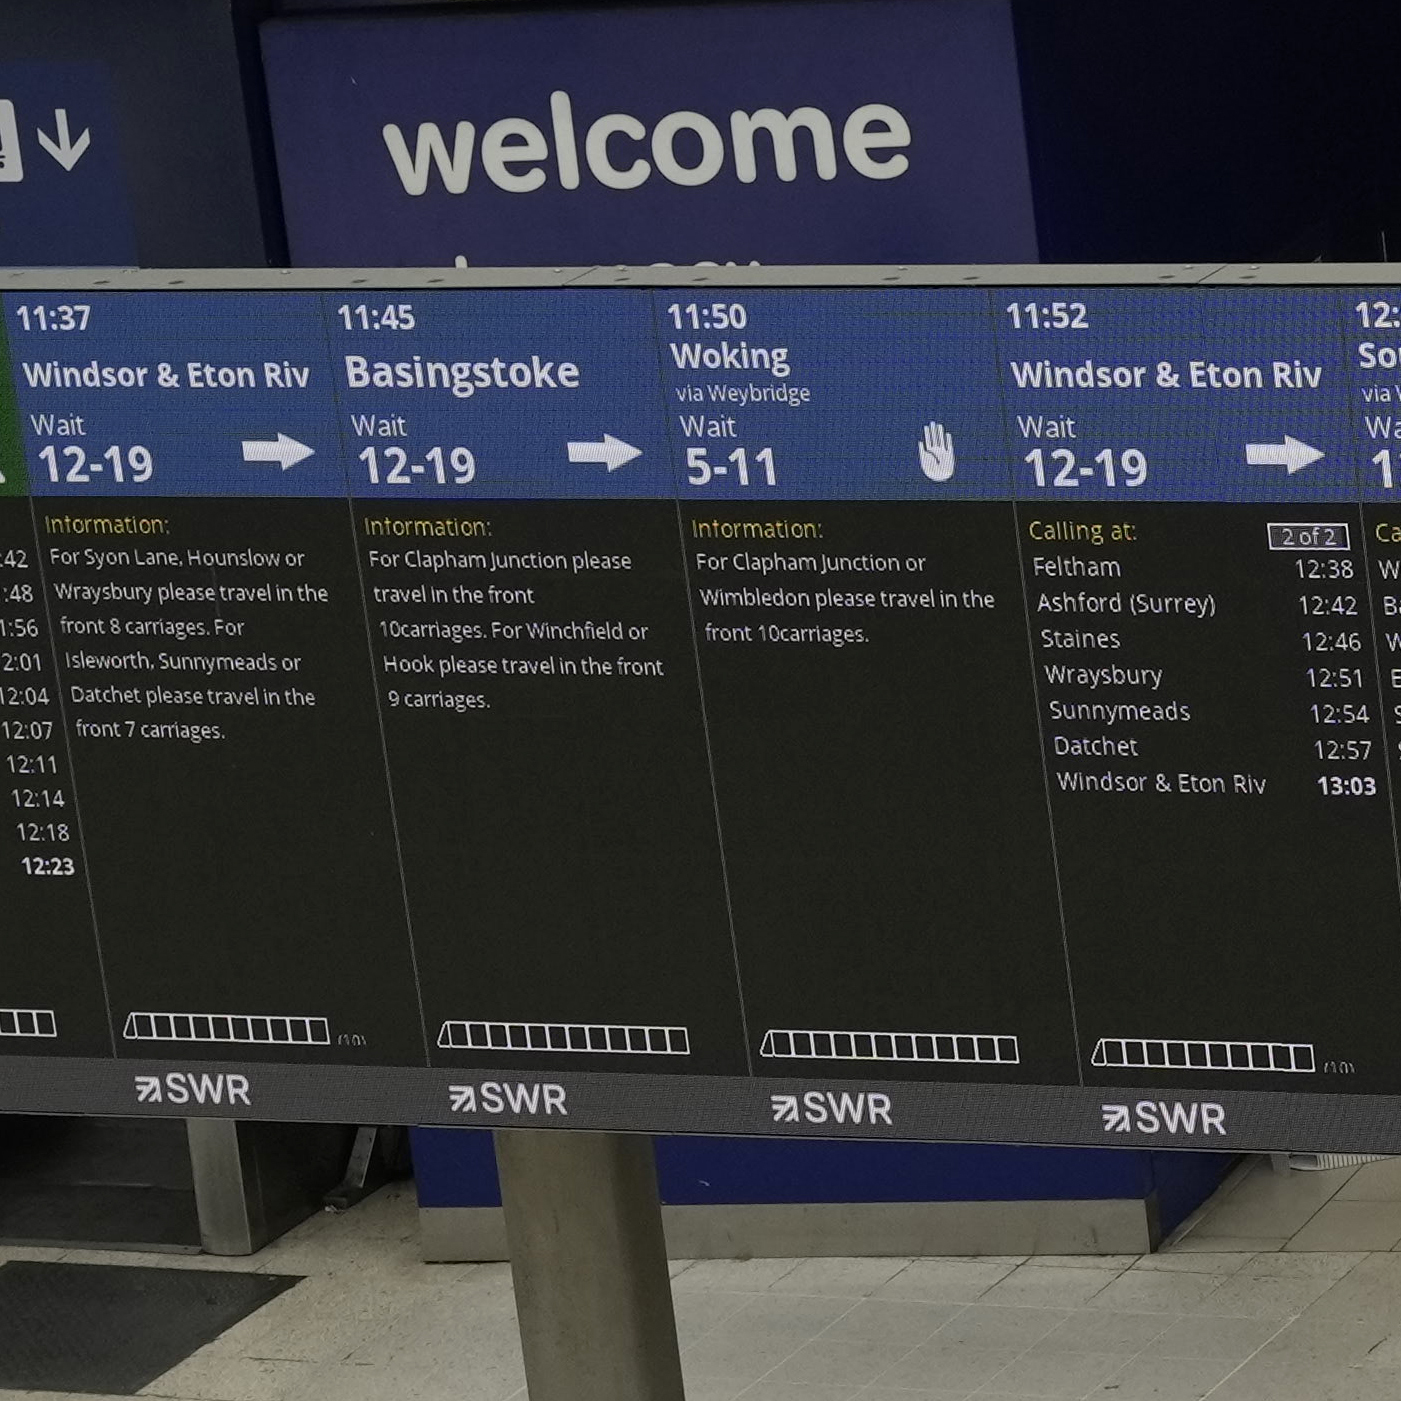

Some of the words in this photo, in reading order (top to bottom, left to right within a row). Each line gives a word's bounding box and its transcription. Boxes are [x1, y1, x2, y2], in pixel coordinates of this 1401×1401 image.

[382, 90, 912, 196] welcome
[16, 305, 91, 331] 11:37
[337, 304, 416, 330] 11:45
[667, 303, 747, 330] 11:50
[1006, 302, 1089, 329] 11:52
[669, 341, 791, 378] Woking
[22, 360, 148, 388] Windsor
[157, 362, 180, 388] &
[187, 362, 256, 388] Eton
[263, 360, 309, 388] Riv
[345, 355, 579, 398] Basingstoke
[1010, 360, 1146, 388] Windsor
[1156, 361, 1180, 388] &
[1189, 361, 1263, 388] Eton
[1272, 360, 1322, 388] Riv
[675, 381, 704, 402] via
[707, 382, 811, 407] Weybridge
[1359, 382, 1392, 403] via
[30, 412, 87, 436] Wait
[350, 414, 408, 437] Wait
[679, 414, 737, 438] Wait
[1016, 414, 1077, 438] Wait
[38, 445, 153, 483] 12-19
[359, 446, 475, 484] 12-19
[686, 447, 776, 486] 5-11
[1024, 448, 1147, 487] 12-19
[1029, 520, 1104, 546] Calling
[1033, 555, 1121, 577] Feltham
[1295, 558, 1354, 579] 12:38
[53, 581, 153, 605] Wraysbury
[157, 581, 216, 606] please
[218, 583, 272, 602] travel
[276, 587, 294, 602] in
[296, 583, 329, 602] the
[699, 587, 811, 607] Wimbledon
[814, 587, 876, 612] please
[879, 588, 936, 608] travel
[939, 589, 958, 608] in
[962, 589, 995, 609] the
[1037, 591, 1122, 613] Ashford
[1129, 593, 1216, 619] (Surrey)
[1299, 595, 1358, 616] 12:42
[491, 621, 523, 640] For
[525, 620, 624, 640] Winchfield
[628, 626, 649, 640] or
[65, 650, 155, 670] Isleworth,
[158, 652, 278, 676] Sunnymeads
[281, 657, 302, 672] or
[6, 754, 57, 774] 12:11
[12, 788, 66, 808] 12:14
[16, 822, 70, 842] 12:18
[21, 856, 75, 876] 12:23
[165, 1072, 251, 1106] SWR
[480, 1081, 568, 1115] SWR
[803, 1091, 893, 1125] SWR
[1135, 1100, 1227, 1135] SWR
